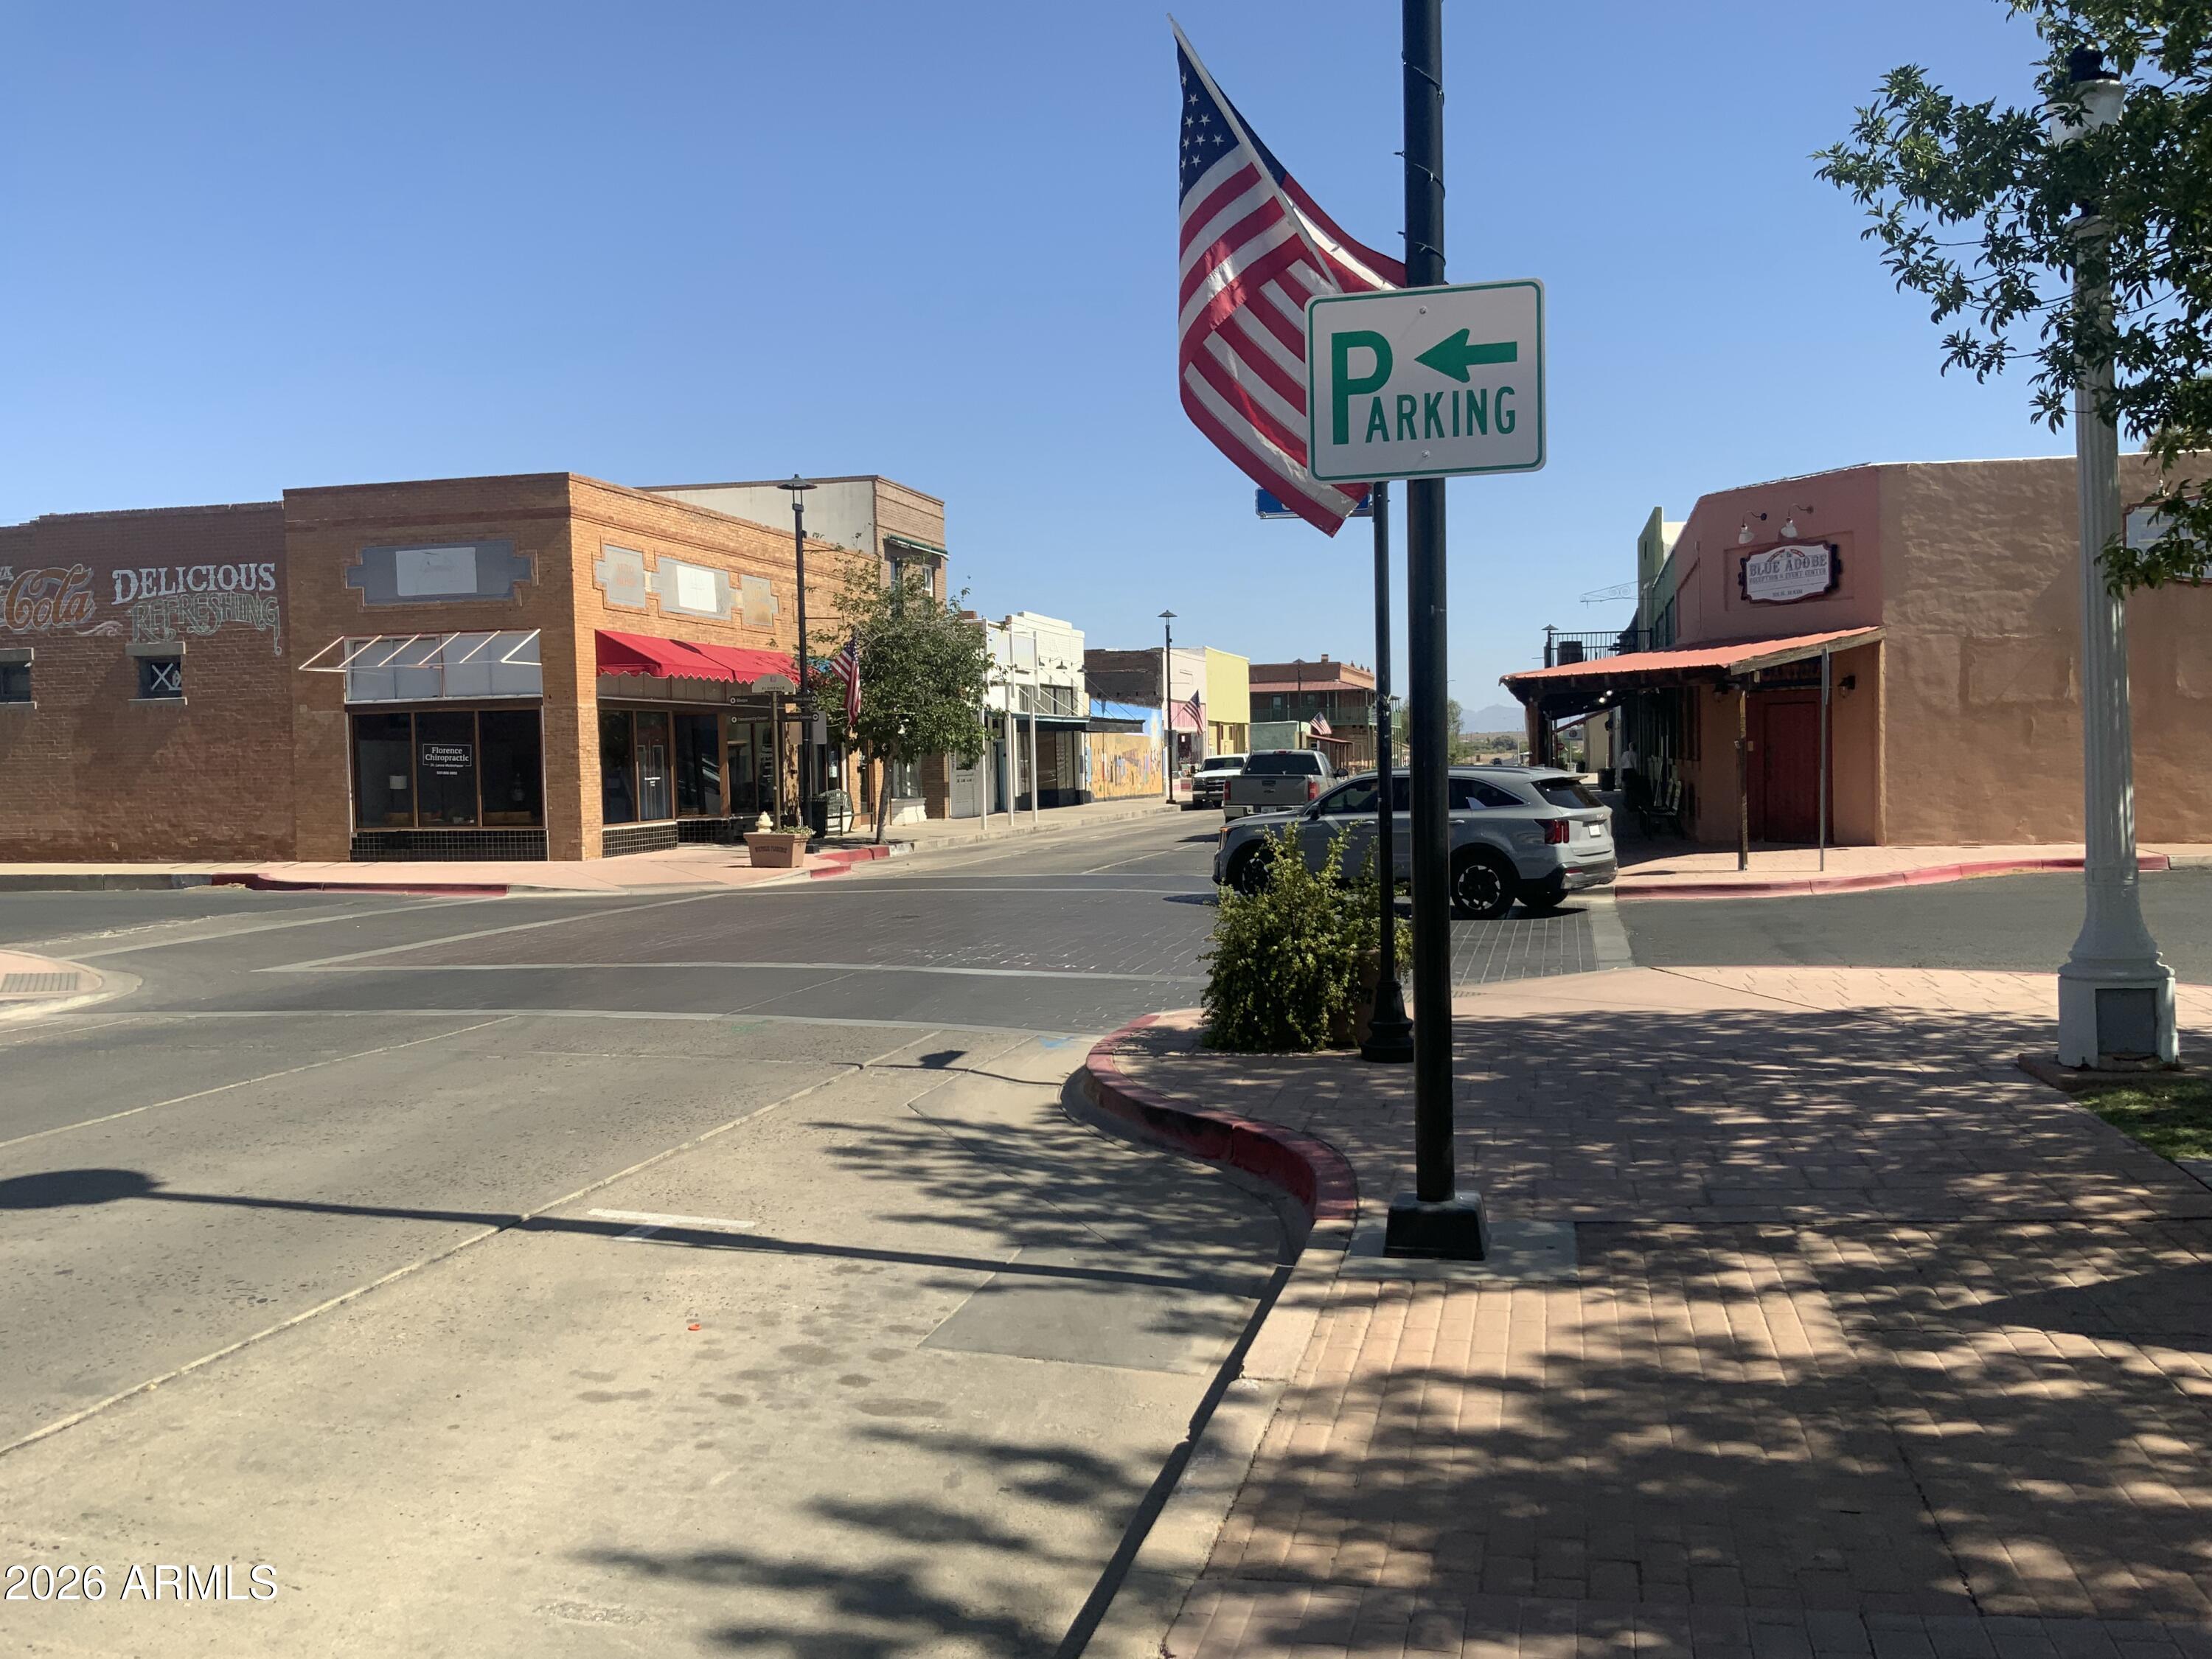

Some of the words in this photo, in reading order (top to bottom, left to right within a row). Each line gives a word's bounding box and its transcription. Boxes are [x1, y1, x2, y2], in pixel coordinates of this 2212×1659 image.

[1331, 330, 1516, 445] PARKING
[111, 563, 276, 605] DELICIOUS
[1749, 560, 1780, 576] BLUE
[1785, 554, 1828, 571] ADOBE
[4, 563, 96, 631] Cola
[130, 591, 282, 655] REFRESHING
[425, 754, 470, 762] Chiropractic
[431, 746, 463, 754] Florence
